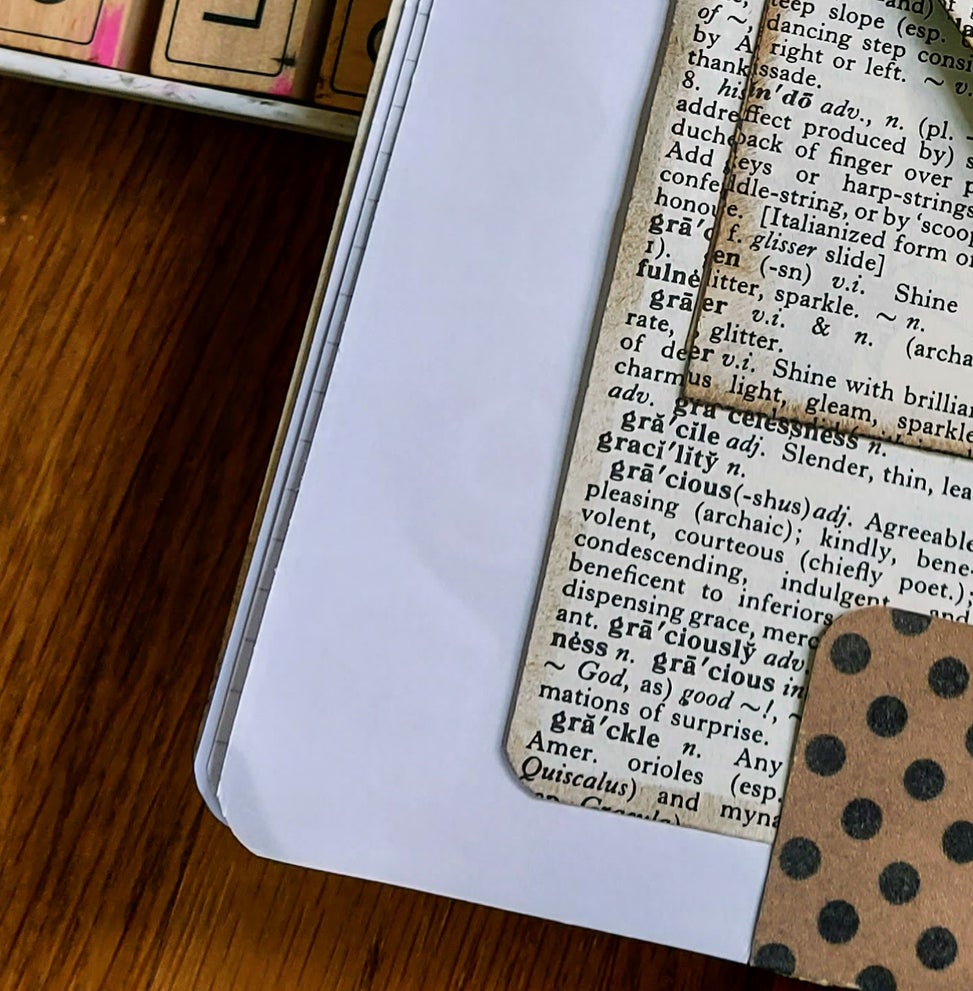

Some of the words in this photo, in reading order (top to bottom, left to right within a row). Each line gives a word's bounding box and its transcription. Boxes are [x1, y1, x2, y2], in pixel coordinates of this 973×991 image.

[759, 204, 887, 250] [Italianized
[892, 233, 948, 263] form
[727, 373, 790, 408] light,
[802, 392, 878, 429] gleam,
[772, 357, 838, 390] Shine
[845, 376, 894, 403] with
[781, 441, 874, 484] Slender,
[883, 464, 934, 497] thin,
[580, 506, 657, 542] volent,
[674, 528, 785, 564] courteous
[799, 548, 884, 589] (chiefly
[584, 479, 680, 520] pleasing
[819, 526, 897, 567] kindly,
